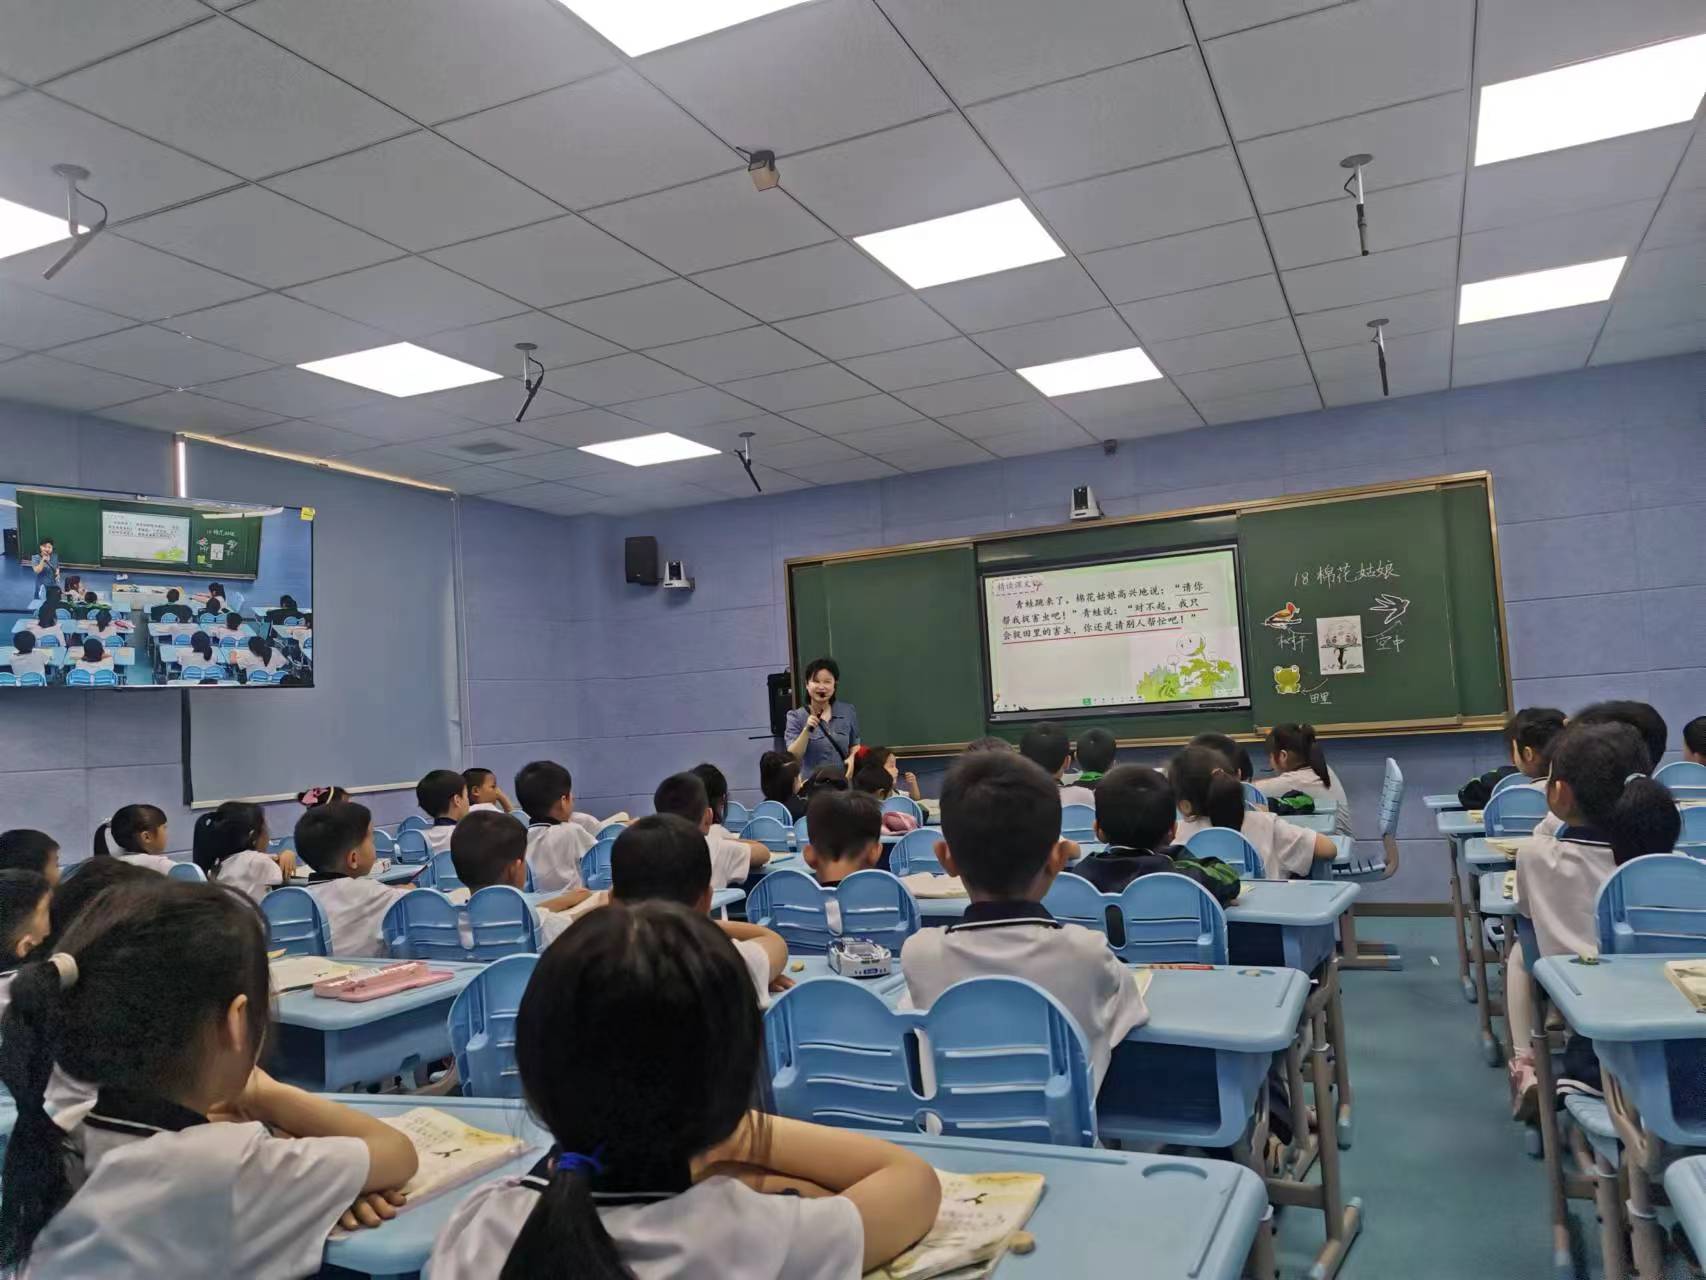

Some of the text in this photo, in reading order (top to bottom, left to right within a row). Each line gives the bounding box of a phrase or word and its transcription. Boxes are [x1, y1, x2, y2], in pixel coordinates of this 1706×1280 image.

[1294, 560, 1400, 589] 18 棉花姑娘
[1375, 634, 1405, 652] 空中
[1310, 691, 1332, 705] 田里
